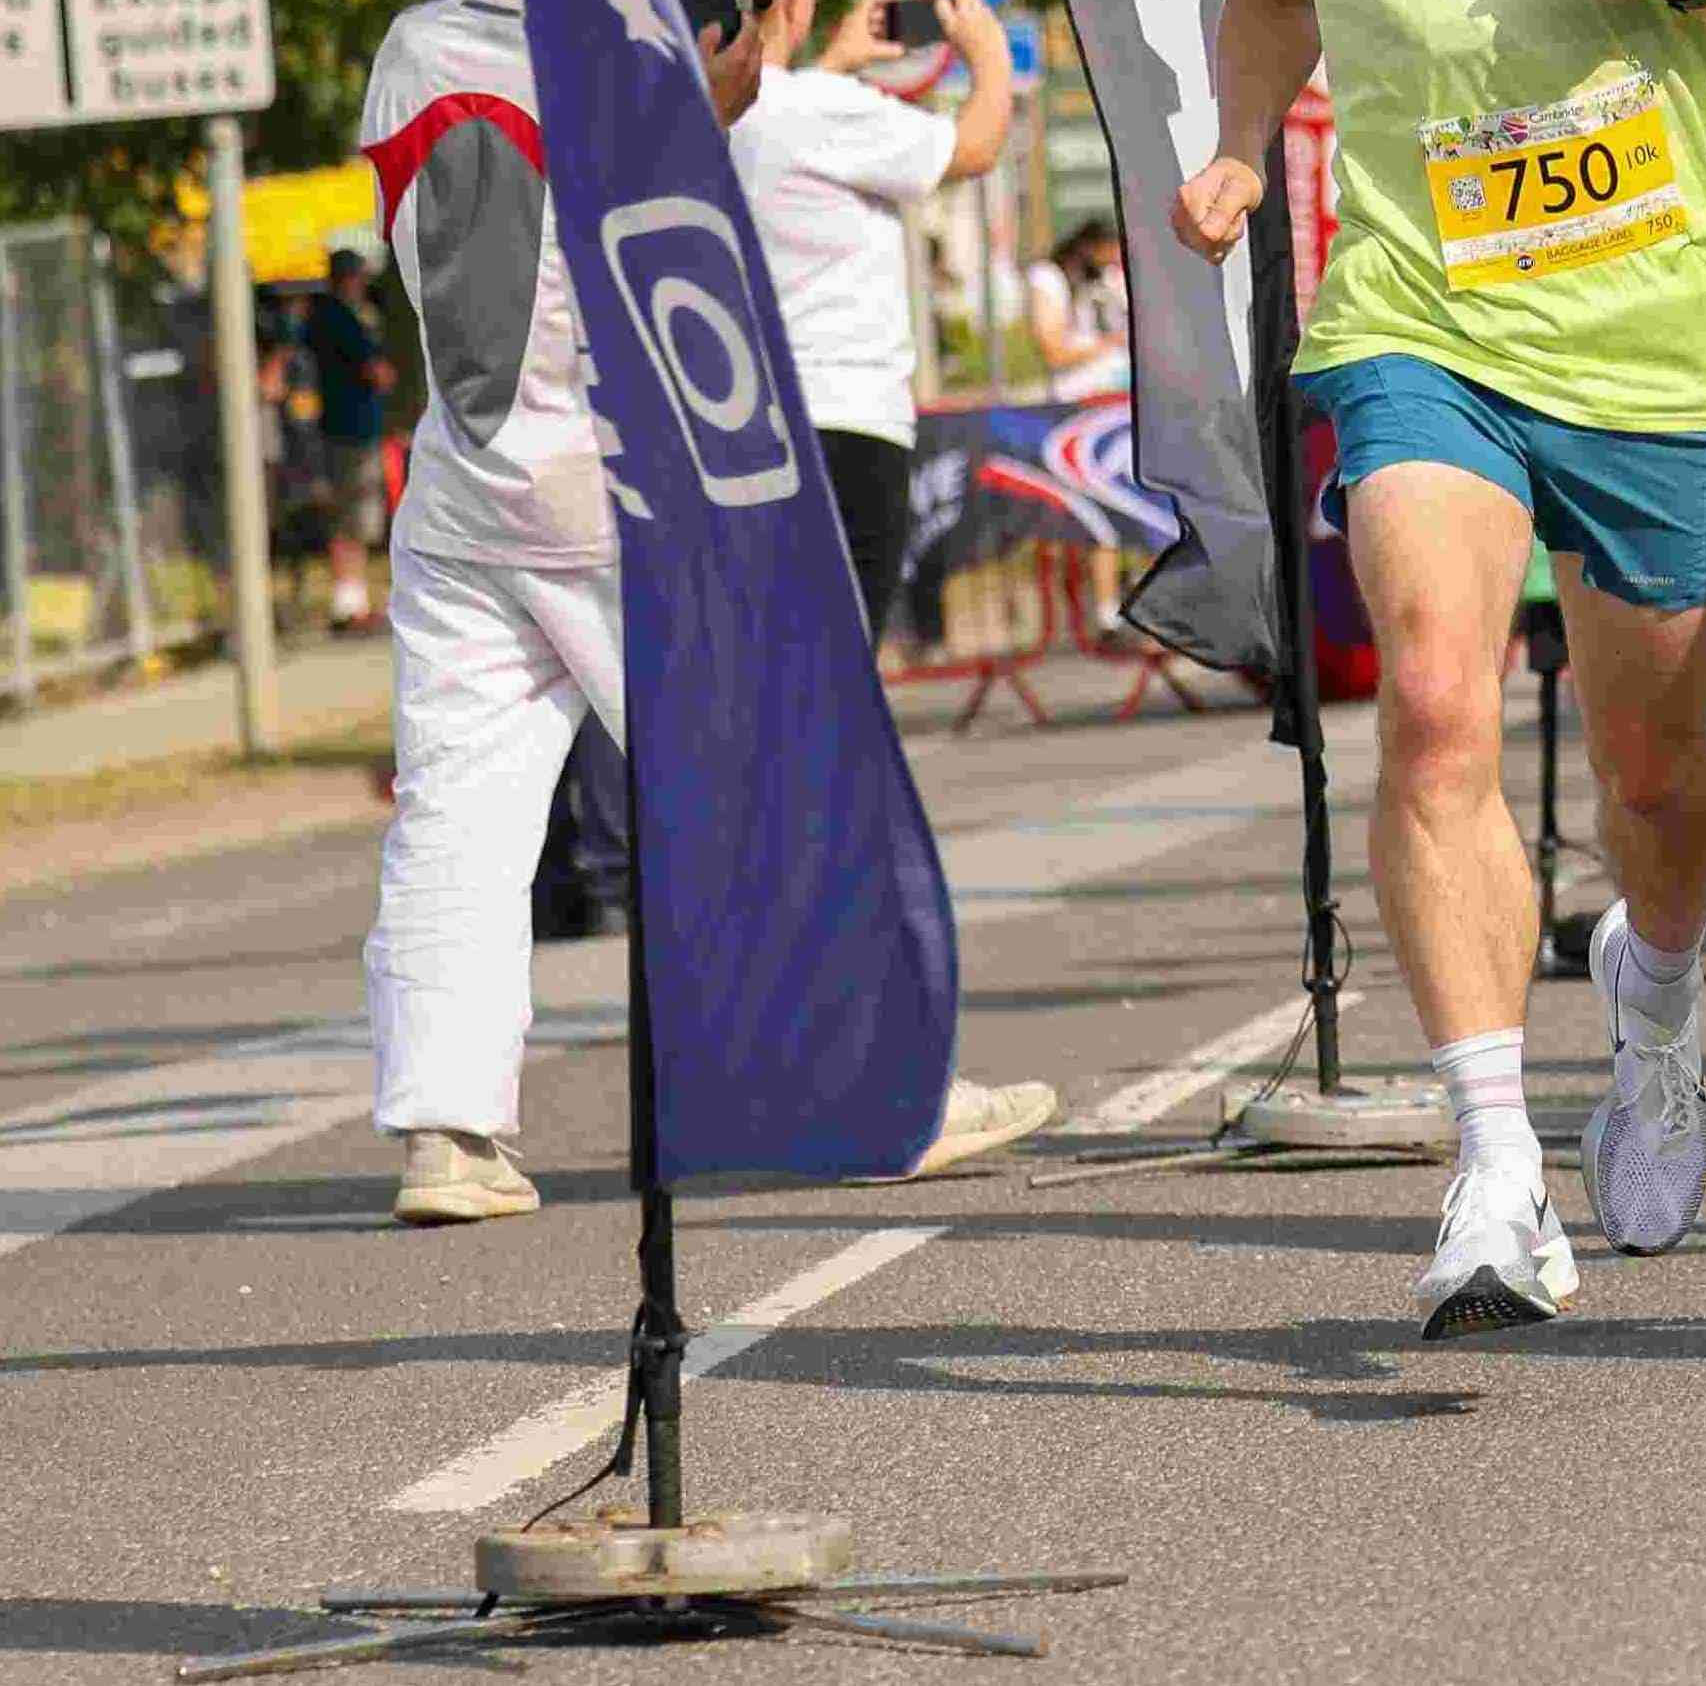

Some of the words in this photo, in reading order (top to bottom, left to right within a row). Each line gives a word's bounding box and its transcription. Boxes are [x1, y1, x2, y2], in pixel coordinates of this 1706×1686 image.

[1489, 141, 1620, 223] 750
[1624, 144, 1660, 171] 10k
[1645, 214, 1674, 237] 750
